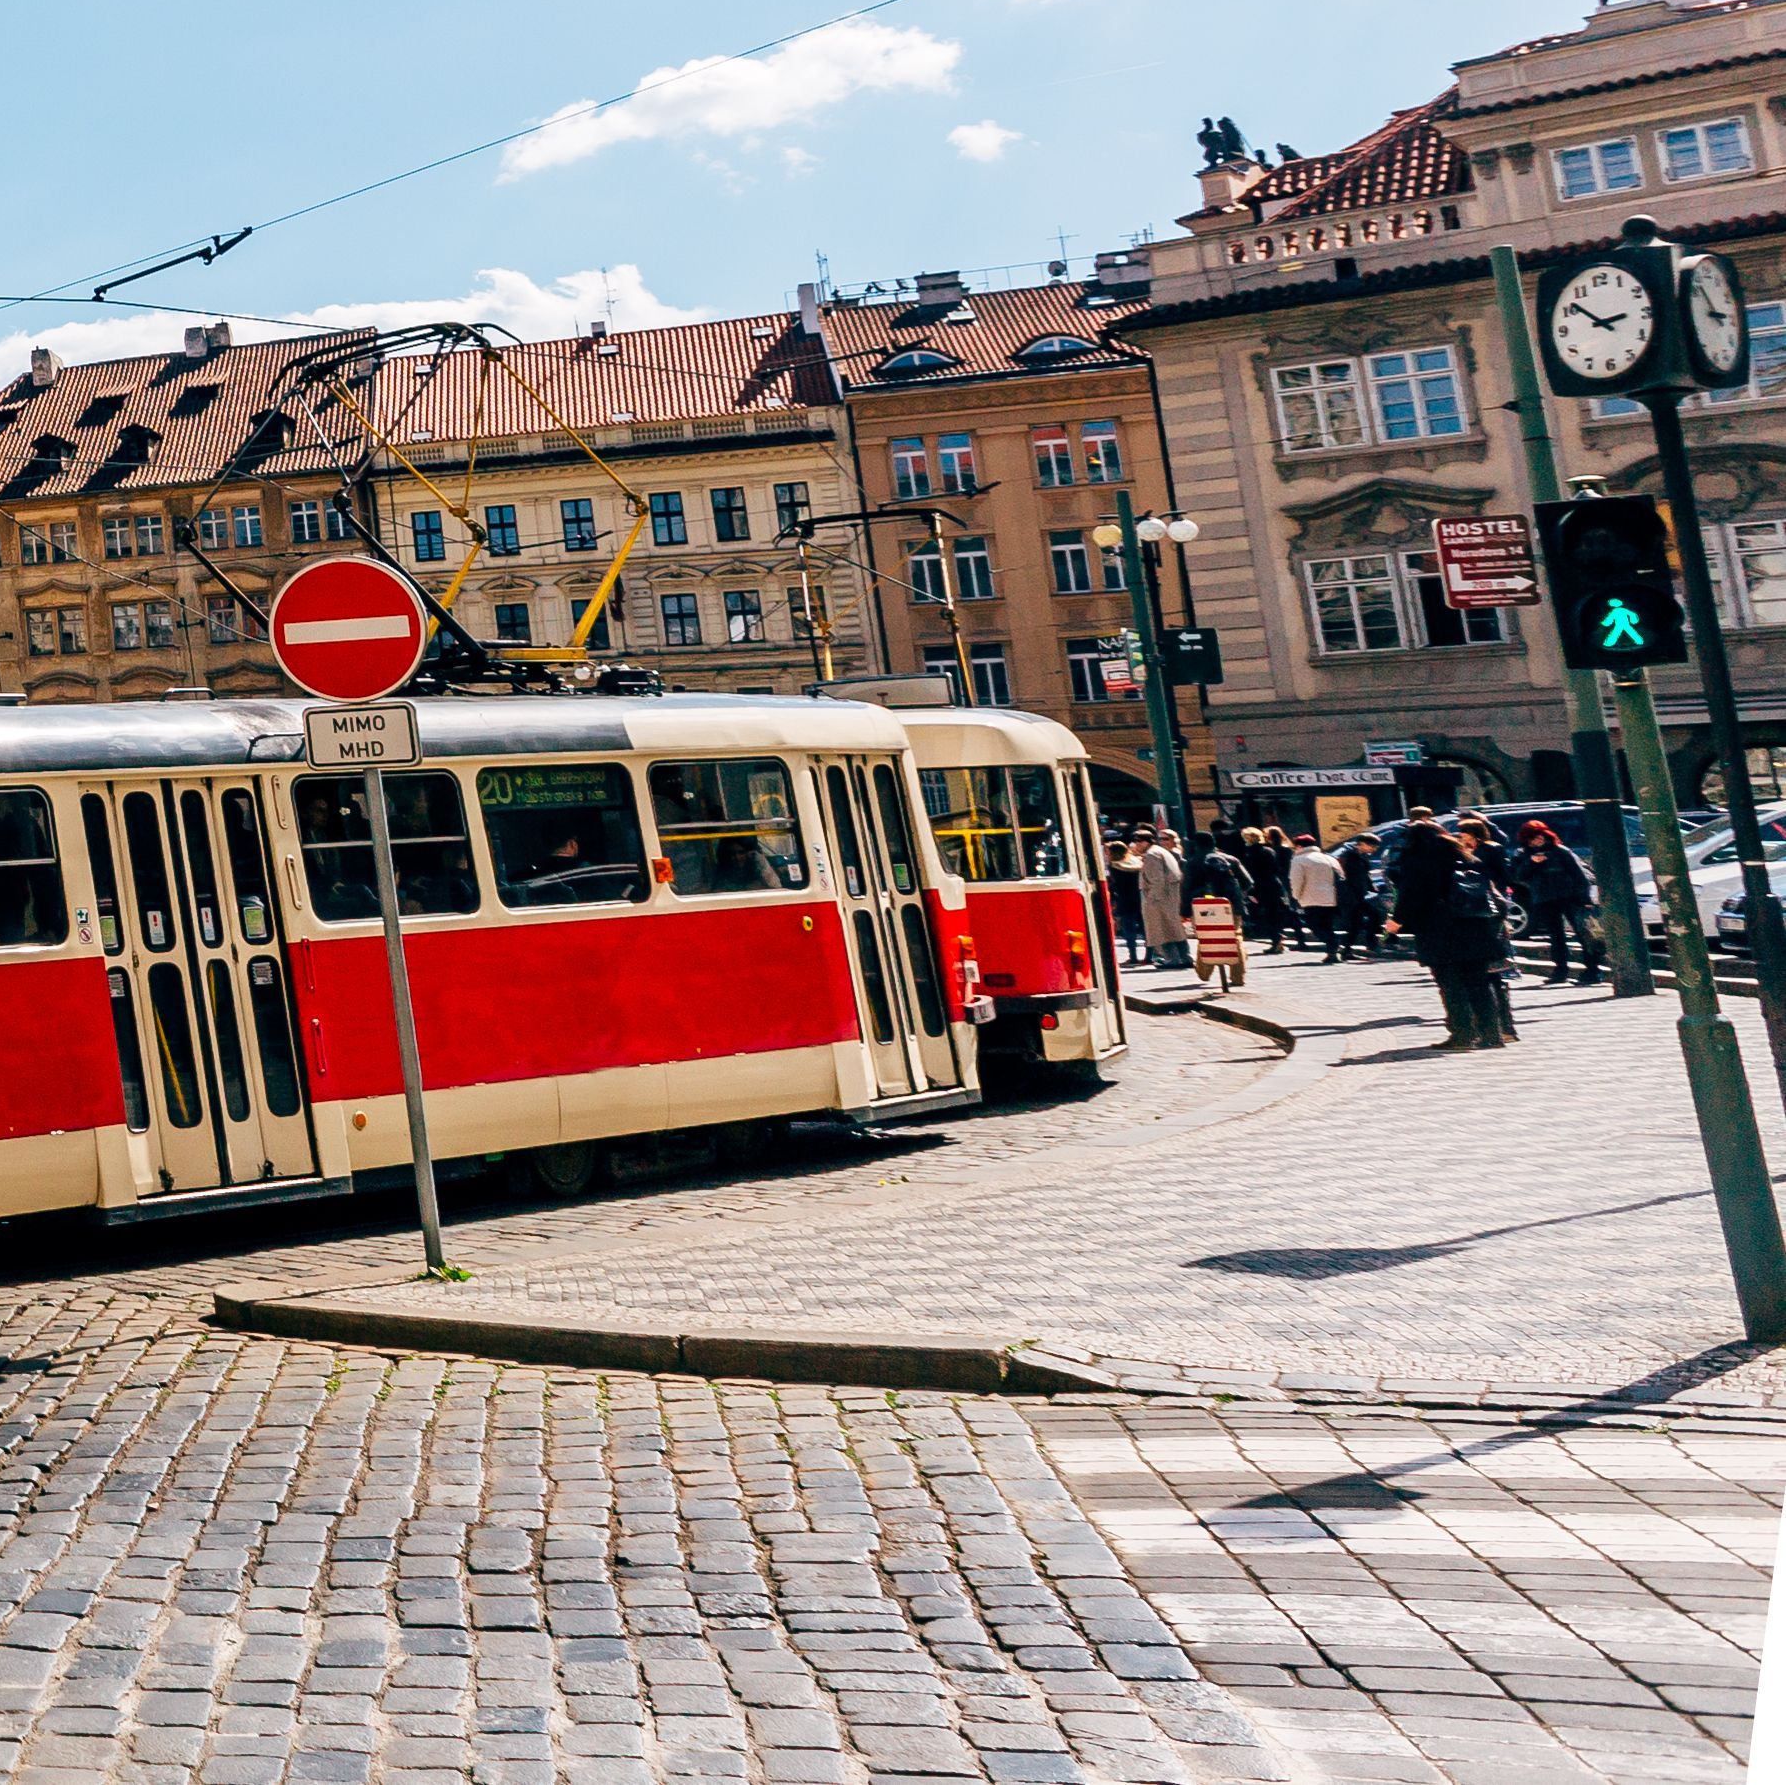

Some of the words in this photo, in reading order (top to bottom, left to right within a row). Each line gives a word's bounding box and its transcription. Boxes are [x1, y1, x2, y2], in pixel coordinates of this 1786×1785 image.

[1591, 272, 1608, 287] 12
[1616, 275, 1623, 288] 1
[1574, 285, 1588, 299] 11
[1631, 286, 1642, 299] 2
[1641, 306, 1651, 320] 3
[1558, 325, 1568, 338] 9
[1637, 328, 1647, 342] 4
[1625, 349, 1635, 362] 5
[1584, 357, 1594, 370] 7
[1605, 358, 1616, 371] 6
[1441, 520, 1525, 537] HOSTEL
[332, 715, 386, 733] MIMO
[339, 740, 384, 759] MHD
[1236, 771, 1306, 786] Coffee
[479, 771, 513, 805] 20
